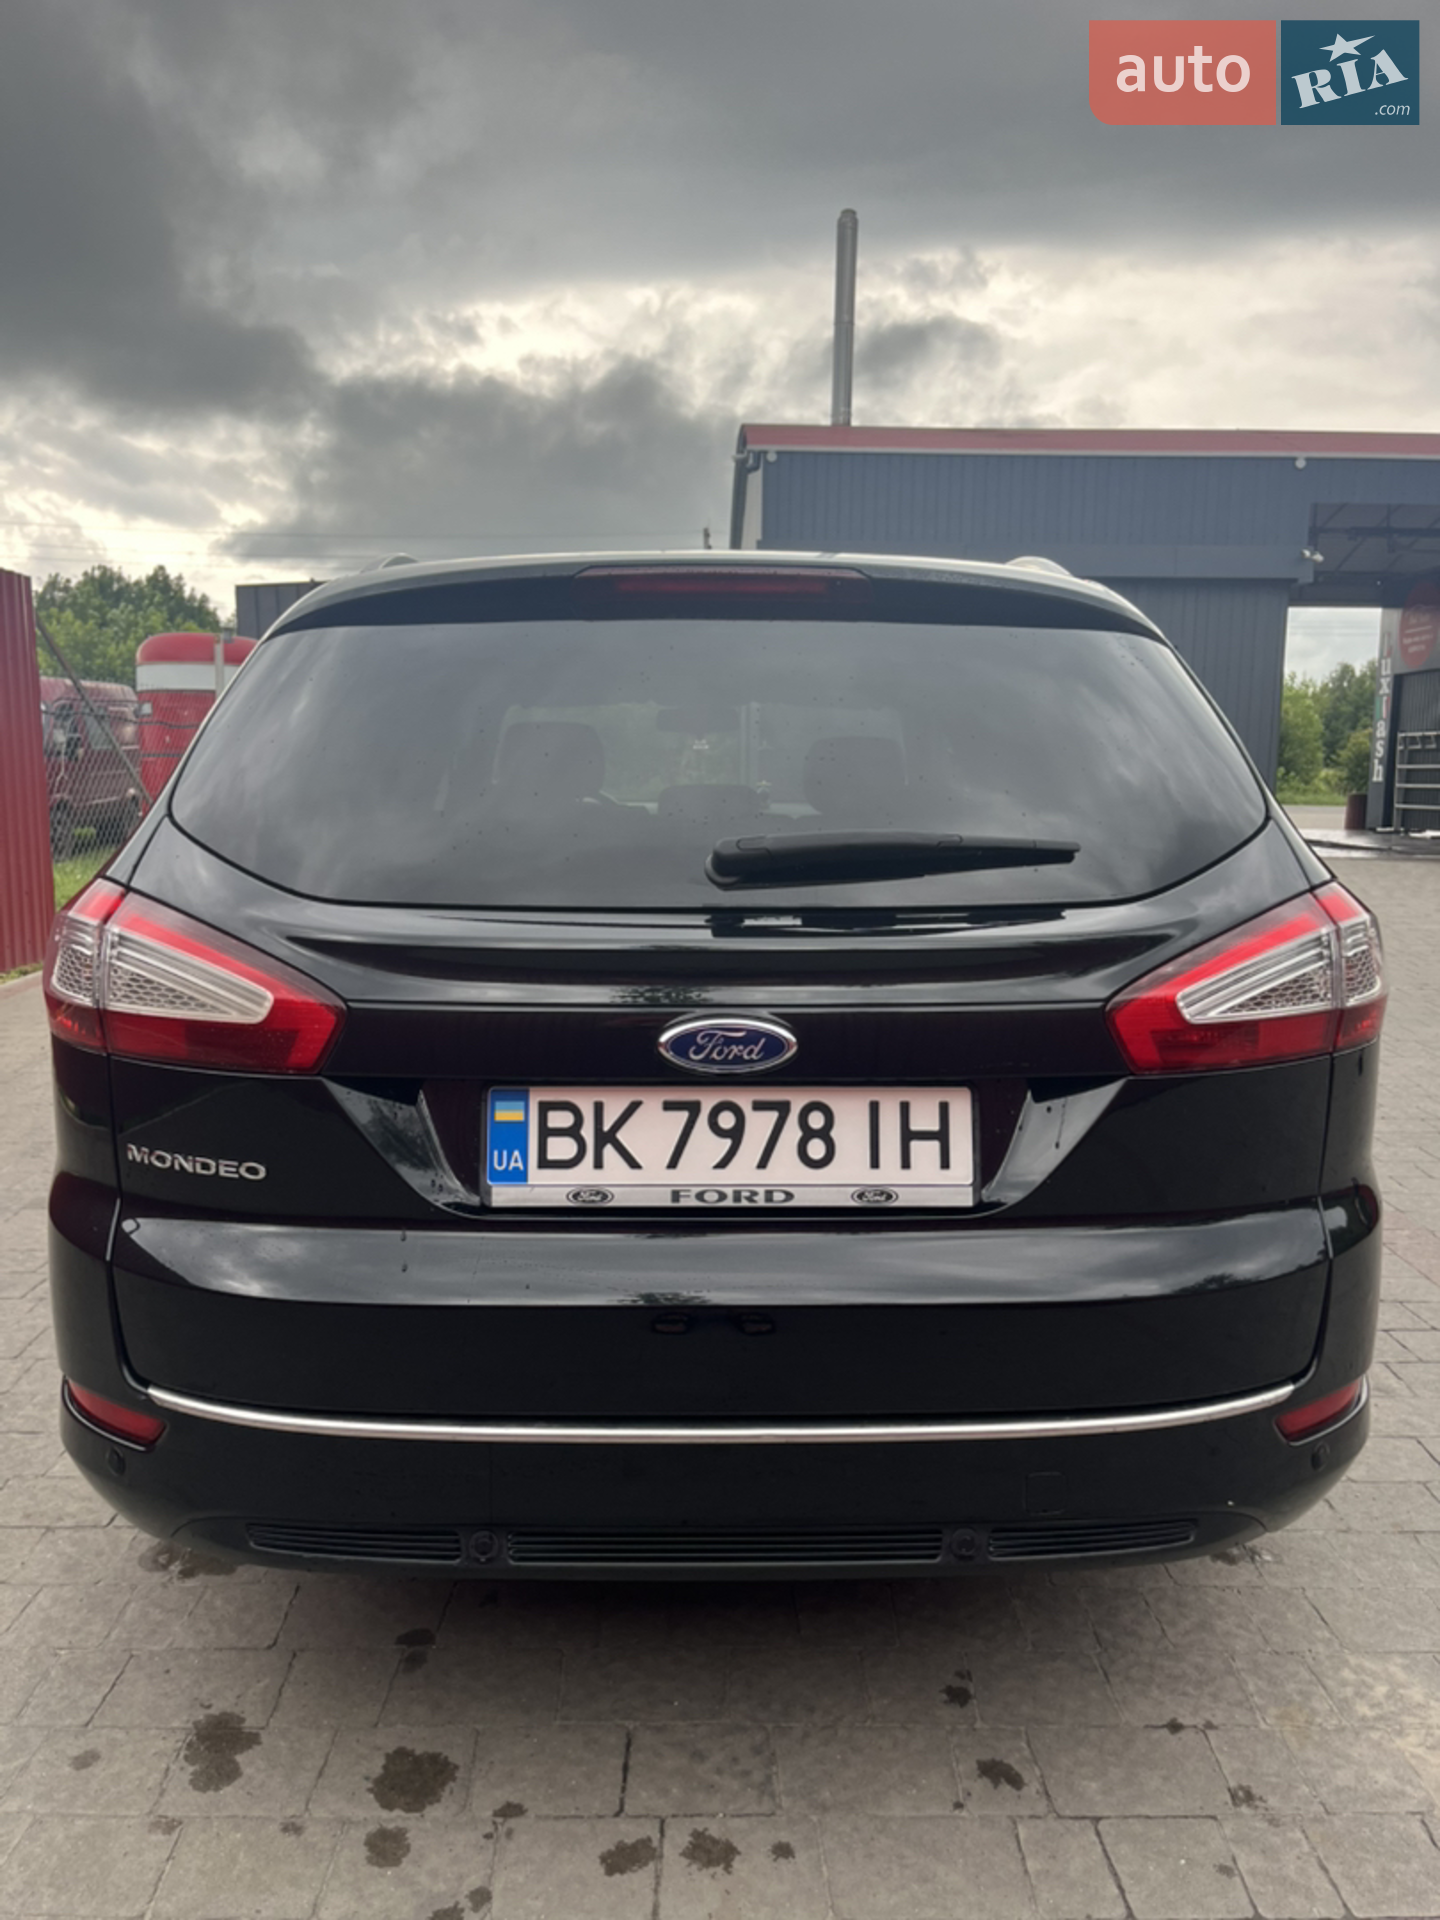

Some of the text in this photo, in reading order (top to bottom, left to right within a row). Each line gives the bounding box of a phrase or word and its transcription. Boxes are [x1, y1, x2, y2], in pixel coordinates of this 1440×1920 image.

[688, 1030, 766, 1061] Ford
[537, 1100, 950, 1170] BK 7978 IH
[126, 1143, 267, 1180] MONDEO
[493, 1150, 524, 1171] UA
[671, 1189, 794, 1204] FORD
